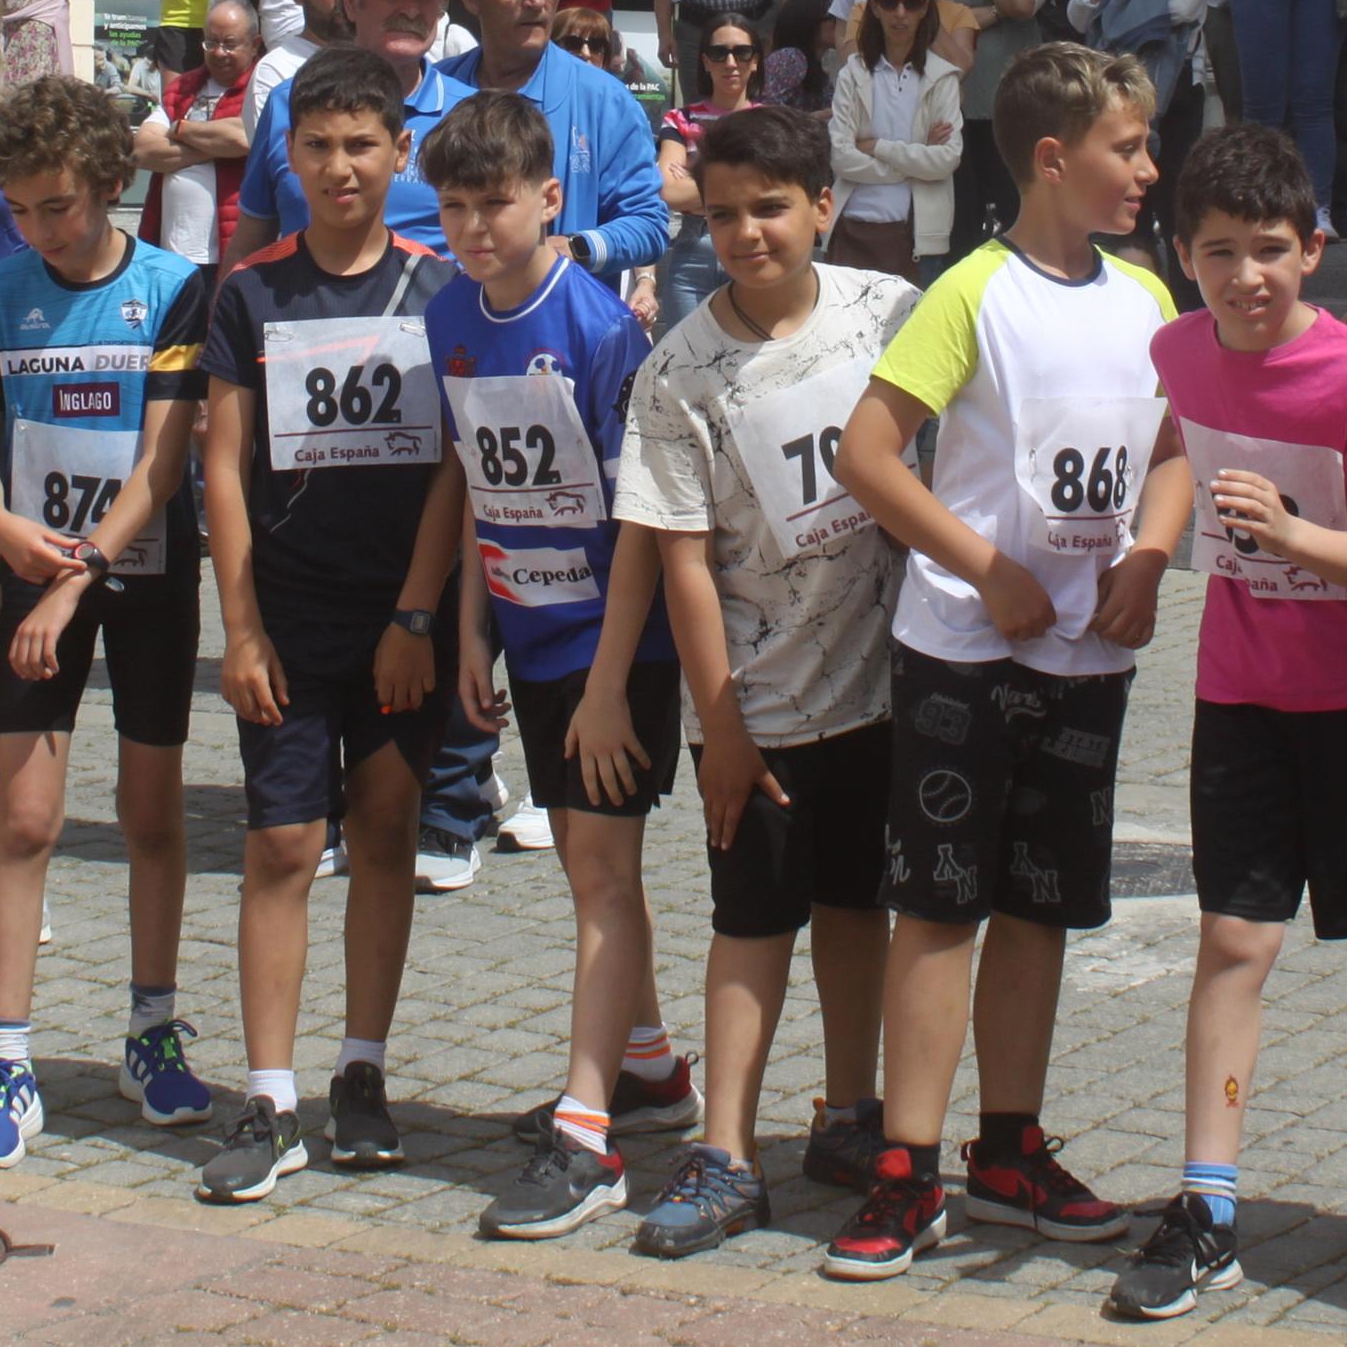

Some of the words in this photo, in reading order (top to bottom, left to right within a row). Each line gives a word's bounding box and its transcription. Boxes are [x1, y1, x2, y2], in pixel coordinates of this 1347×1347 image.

[8, 356, 85, 375] LAGUNA
[59, 389, 112, 412] INGLAGO
[305, 363, 402, 426] 862
[295, 447, 325, 465] Caja
[330, 445, 380, 461] España
[476, 424, 562, 486] 852
[1051, 445, 1127, 512] 868
[43, 471, 122, 533] 874
[503, 506, 544, 522] España
[796, 527, 829, 548] Caja
[513, 566, 592, 586] Cepeda
